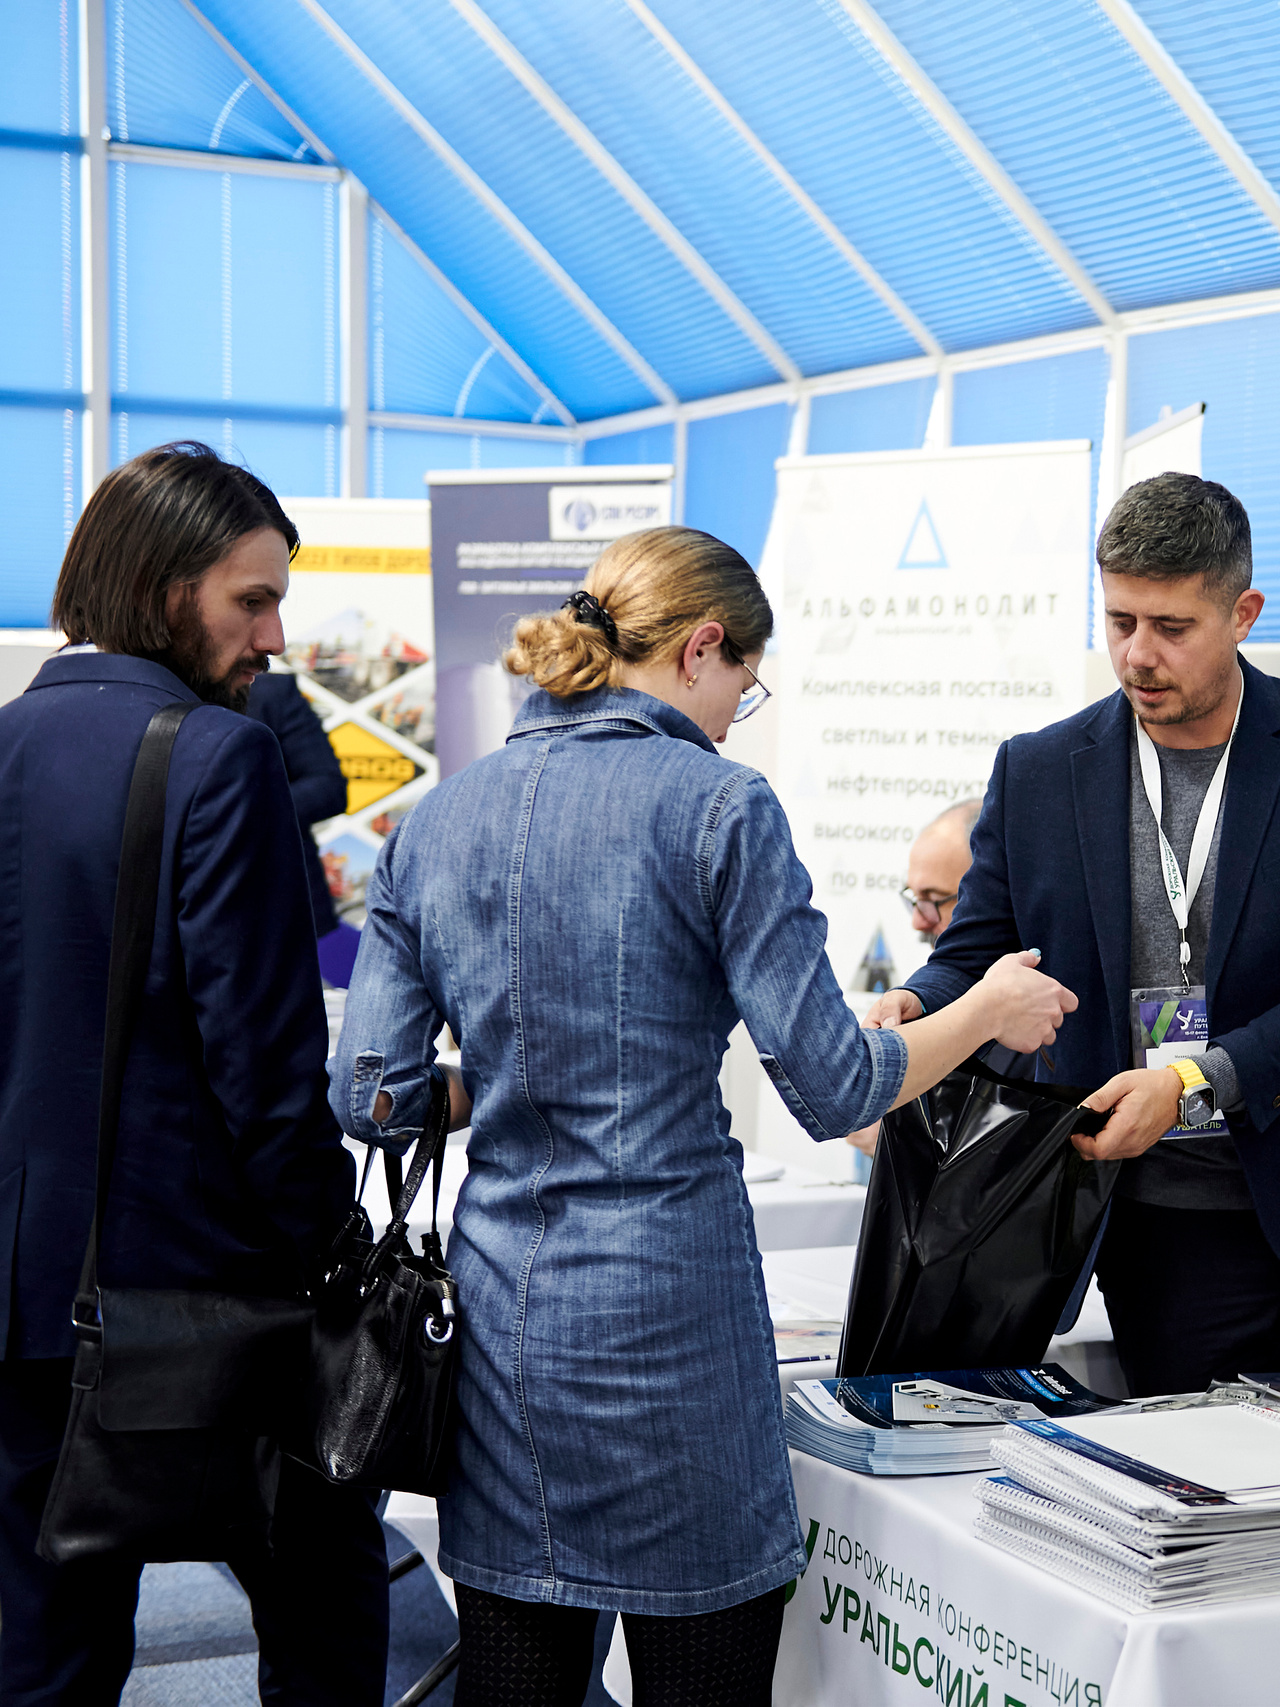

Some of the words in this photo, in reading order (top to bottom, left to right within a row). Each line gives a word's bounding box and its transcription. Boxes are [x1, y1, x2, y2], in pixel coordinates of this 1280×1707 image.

[802, 593, 1058, 618] АЛЬФАМОНОЛИТ
[802, 677, 942, 697] Комплексная
[949, 679, 1053, 698] поставка
[822, 727, 907, 745] светлых
[915, 729, 928, 744] и
[814, 823, 913, 843] высокого
[832, 872, 857, 889] по
[823, 1527, 930, 1617] ДОРОЖНАЯ
[937, 1593, 1103, 1707] КОНФЕРЕНЦИЯ
[819, 1575, 990, 1707] УРАЛЬСКИЙ
